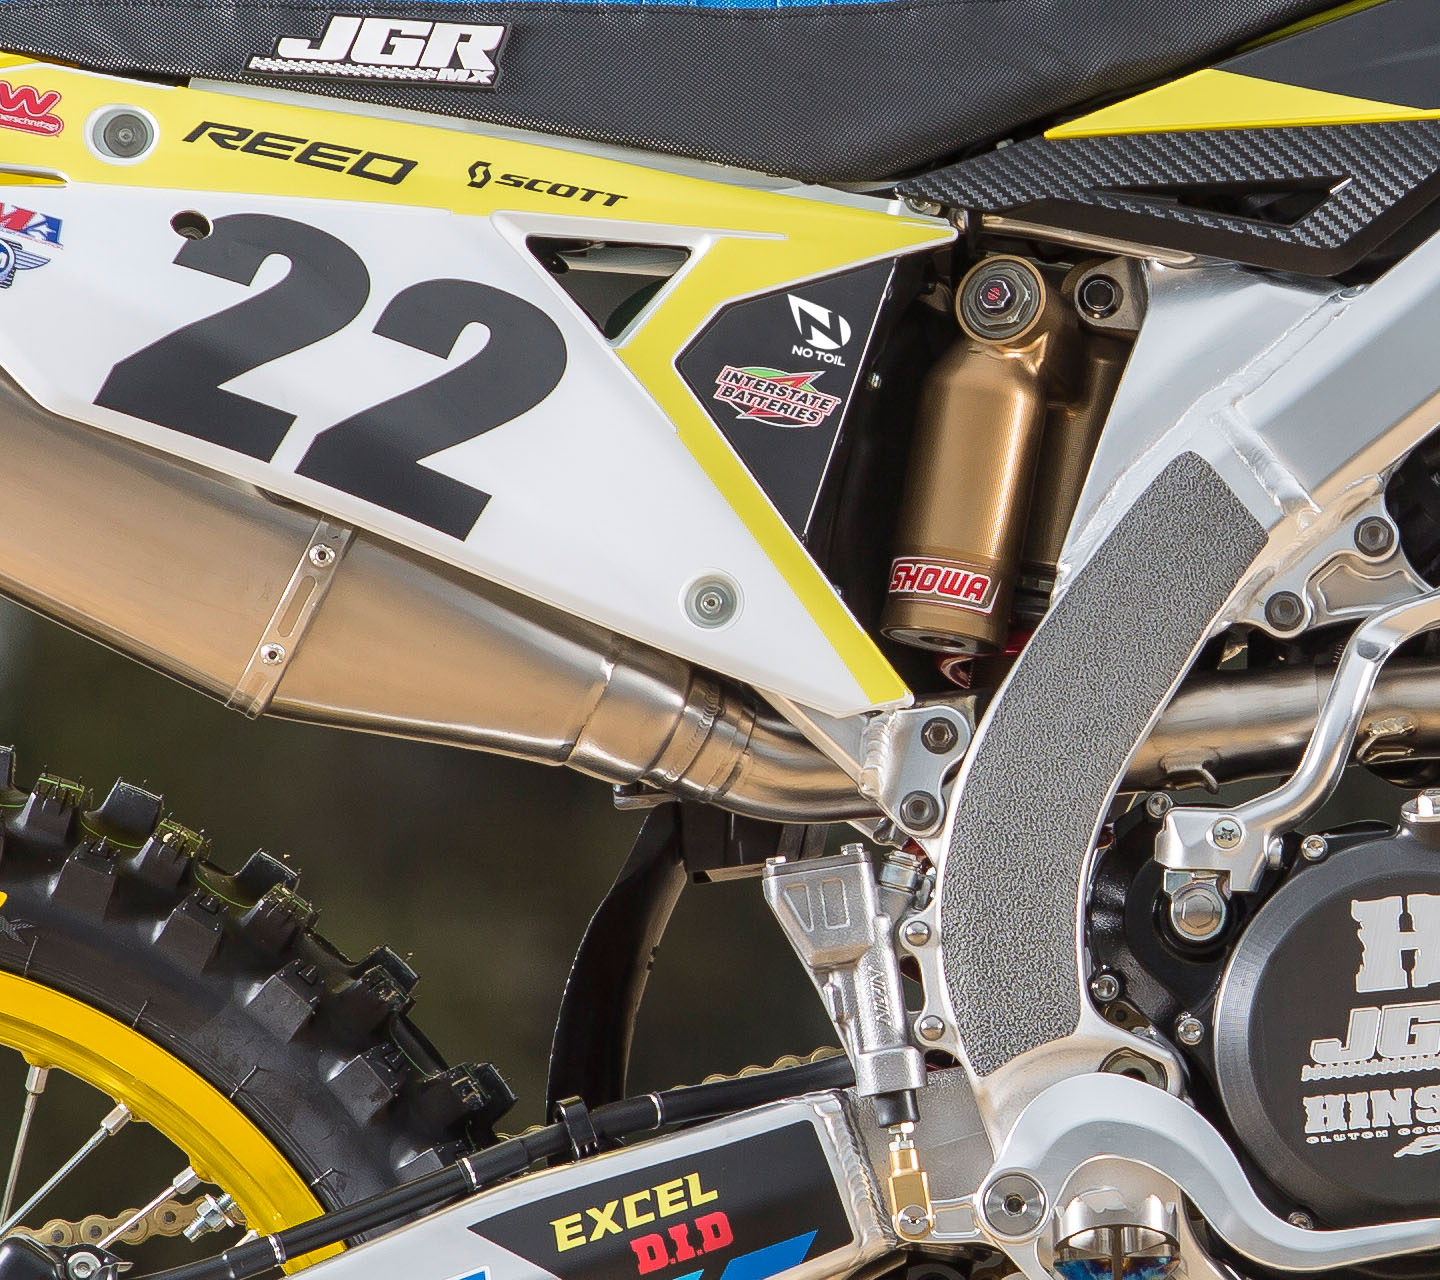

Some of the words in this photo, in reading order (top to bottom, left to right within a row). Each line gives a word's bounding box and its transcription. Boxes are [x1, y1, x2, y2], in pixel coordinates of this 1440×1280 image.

[277, 15, 505, 70] JGR
[437, 67, 494, 85] MX
[182, 122, 418, 186] REED
[494, 170, 628, 208] SCOTT
[93, 213, 568, 542] 22
[791, 344, 815, 363] NO
[816, 349, 846, 367] TOIL
[719, 384, 822, 425] BATTERIES
[721, 366, 836, 413] INTERSTATE
[889, 563, 990, 603] SHOWA
[552, 1172, 720, 1253] EXCEL
[630, 1210, 734, 1277] D.I.D
